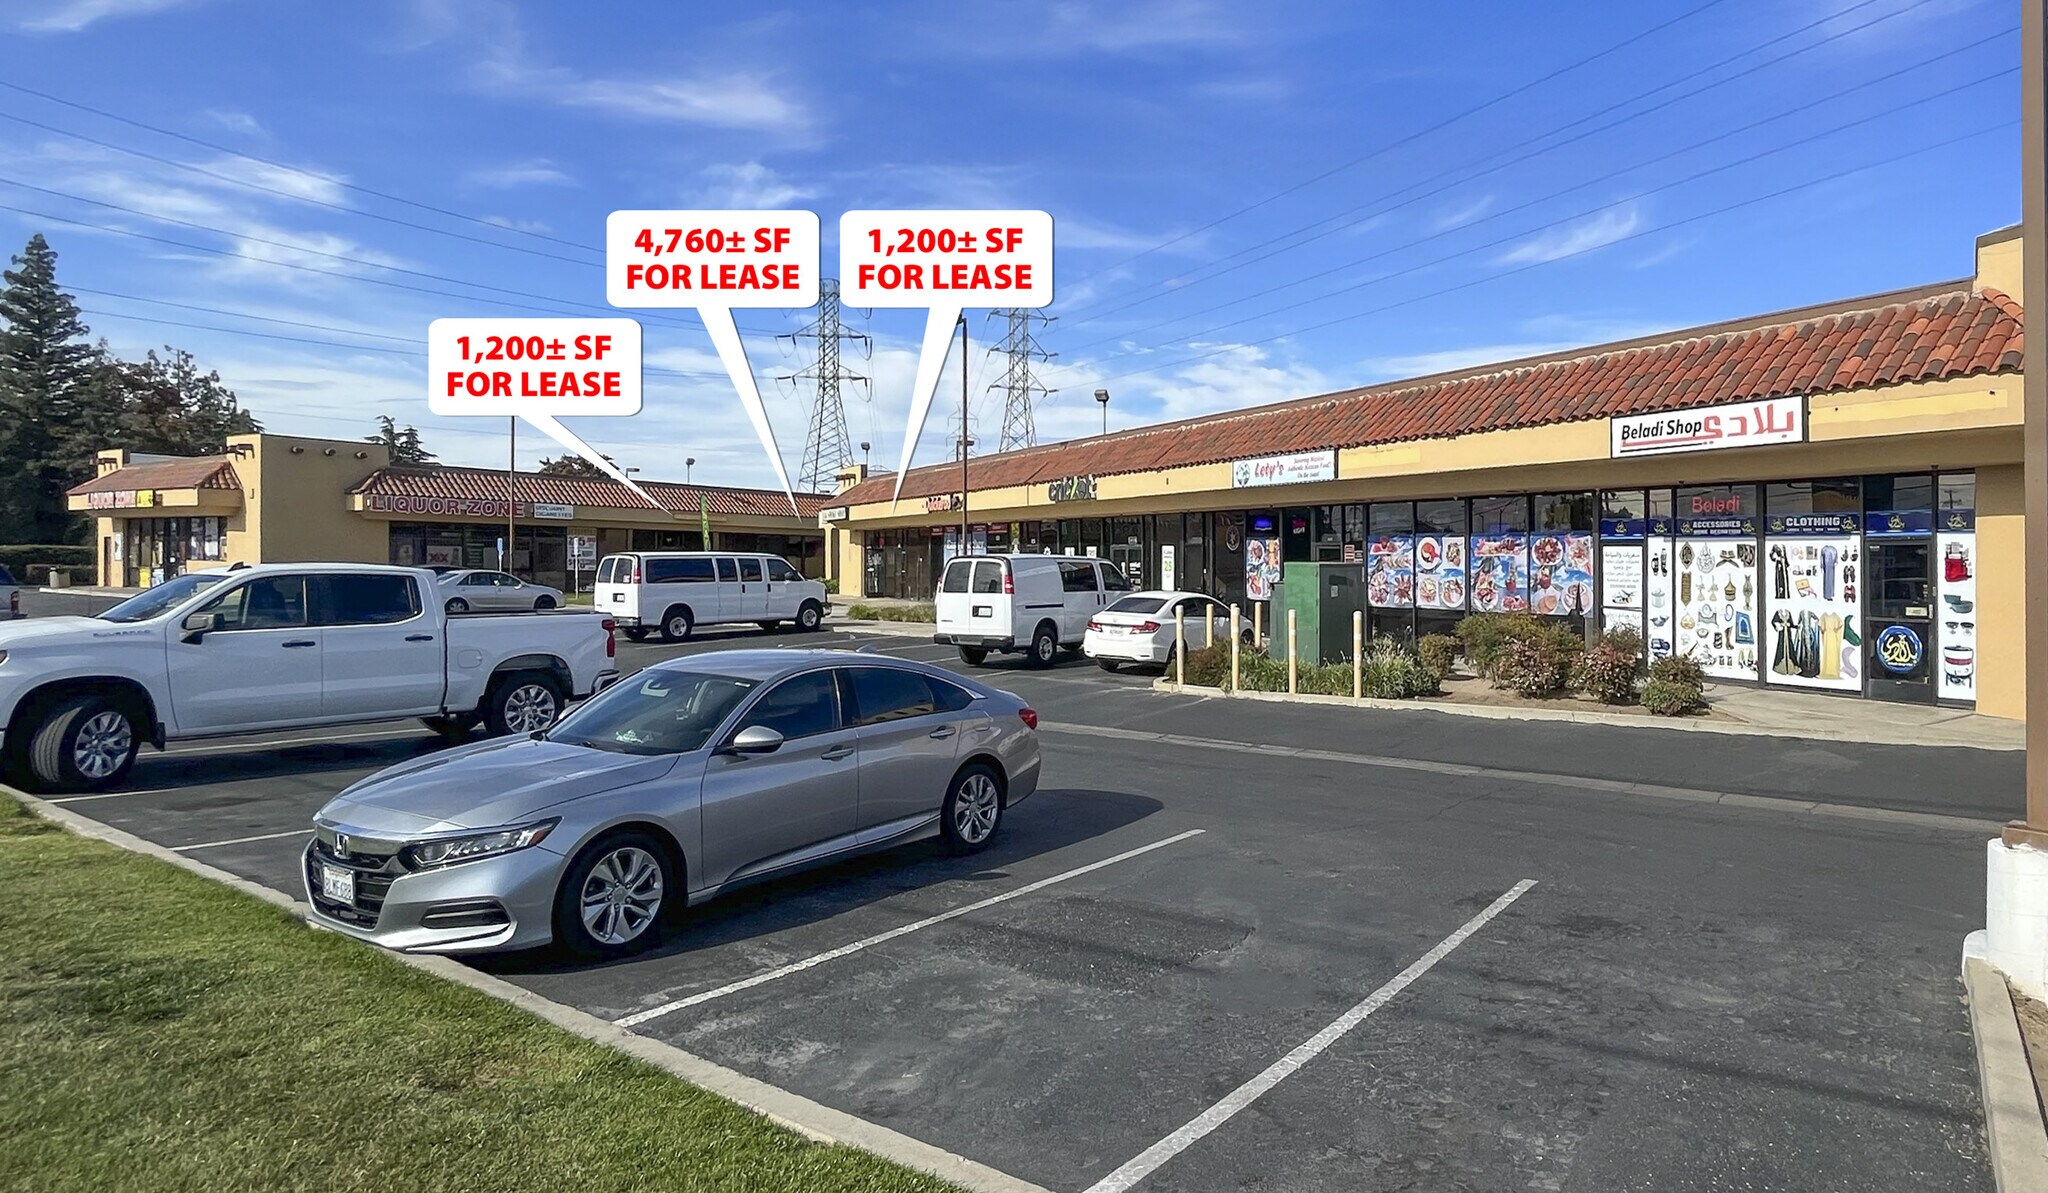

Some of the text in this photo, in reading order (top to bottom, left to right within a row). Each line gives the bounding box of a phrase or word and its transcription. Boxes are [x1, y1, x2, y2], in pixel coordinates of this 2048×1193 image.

[1621, 418, 1703, 441] Beladi Shop
[1254, 460, 1285, 481] Lety's
[370, 495, 525, 517] LIQUOR ZONE
[1692, 495, 1740, 513] Beladi
[1693, 520, 1741, 529] ACCESSORIES
[1786, 517, 1840, 526] CLOTHING
